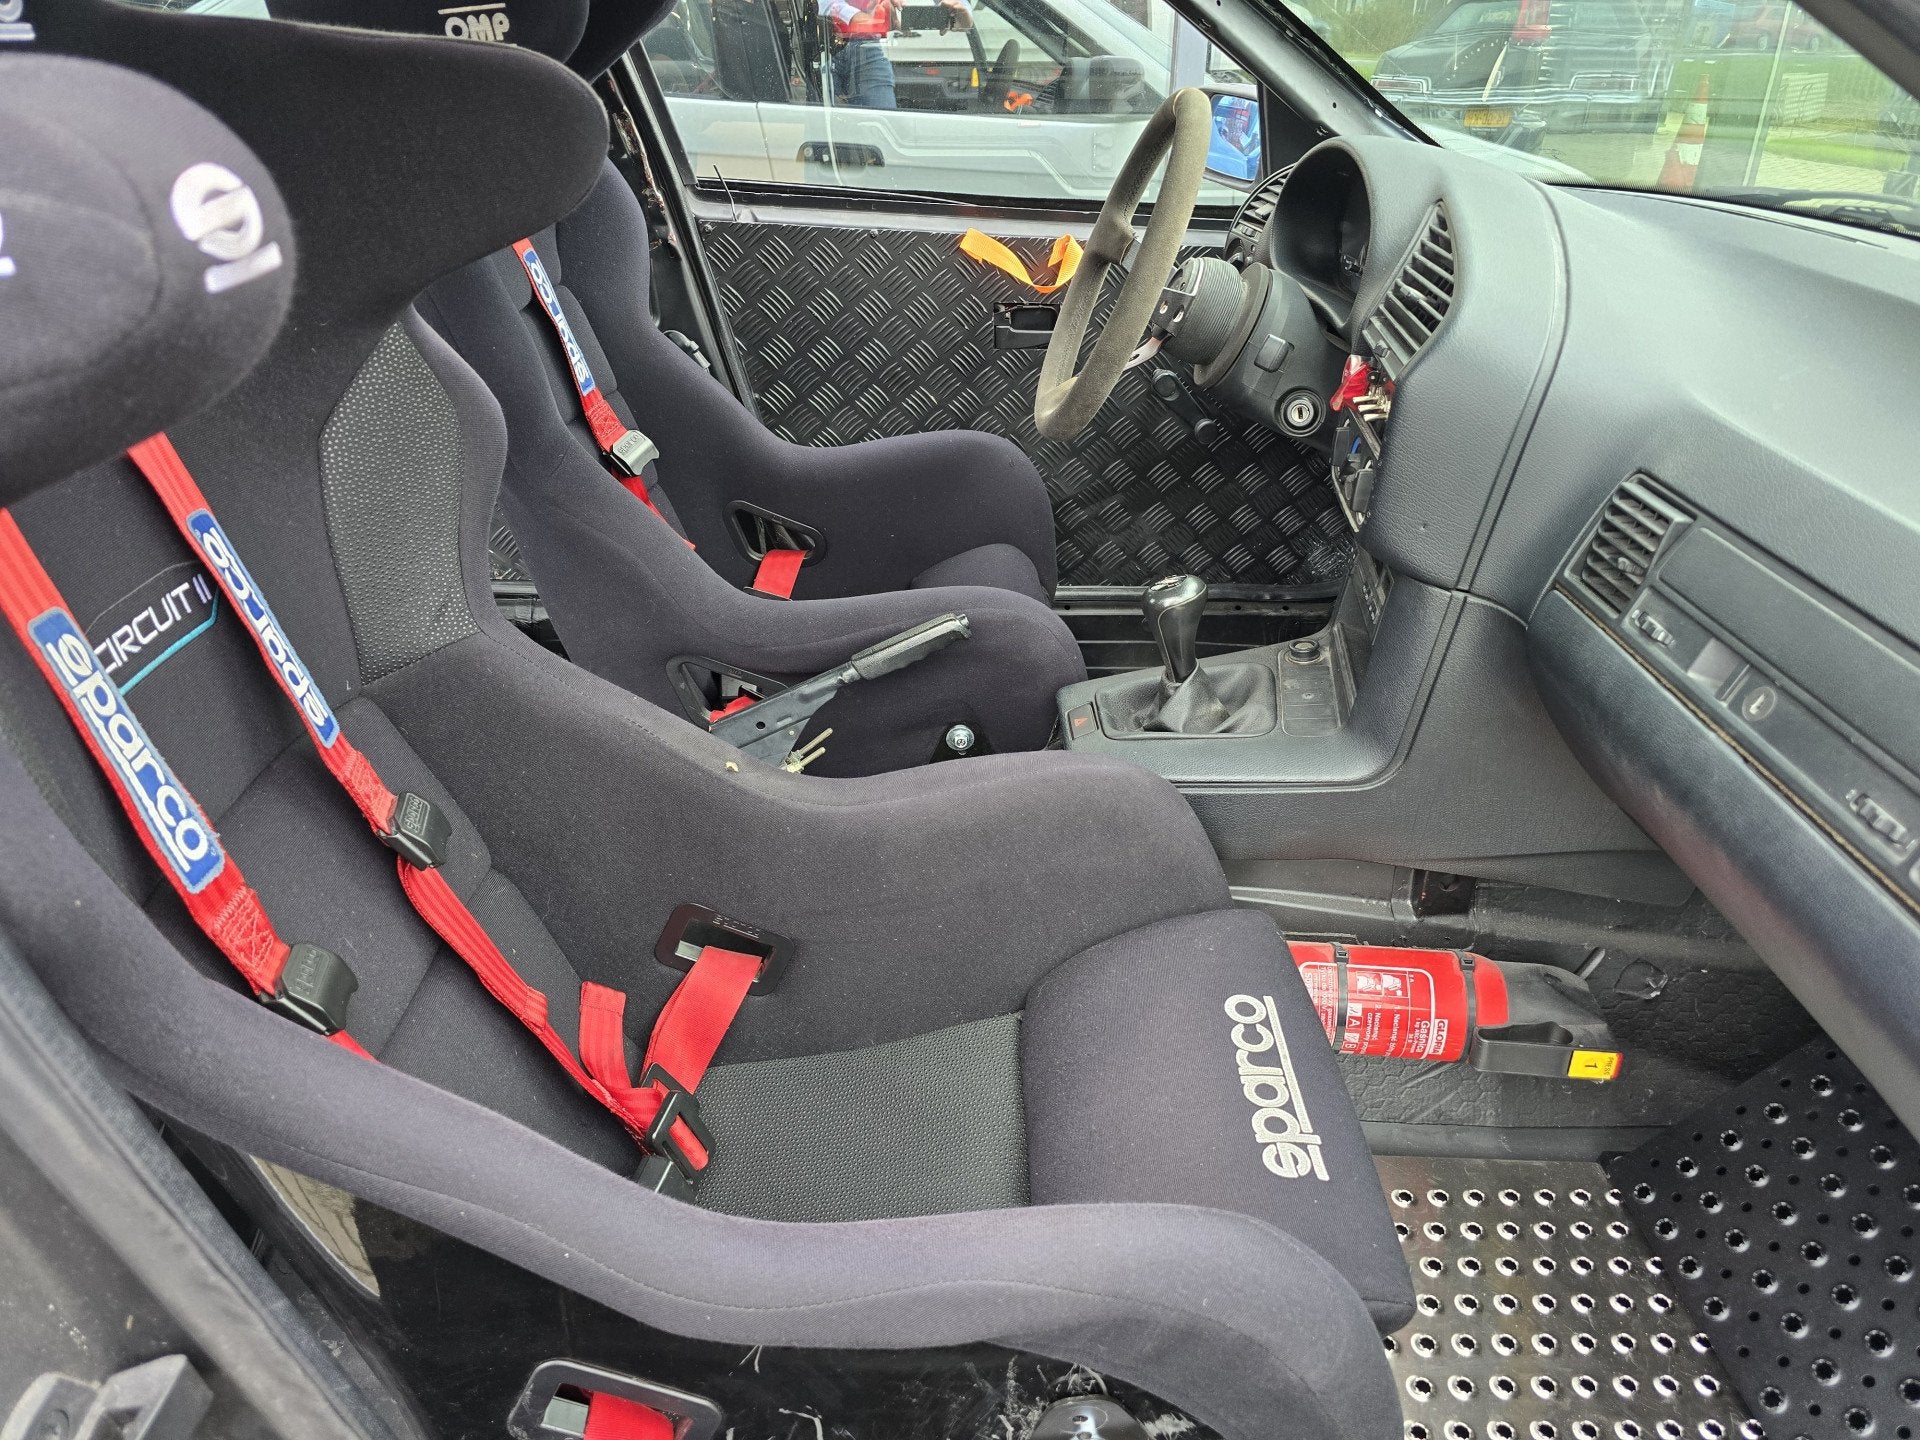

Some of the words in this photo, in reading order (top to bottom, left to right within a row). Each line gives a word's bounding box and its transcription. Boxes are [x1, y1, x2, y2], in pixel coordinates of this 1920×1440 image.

[445, 12, 510, 42] OMP
[202, 527, 329, 727] sparco
[46, 633, 209, 873] sparco
[1348, 1017, 1360, 1027] A
[1415, 1020, 1430, 1053] Gaśnica
[1431, 1020, 1446, 1055] GLORIA
[1224, 994, 1330, 1181] sparco
